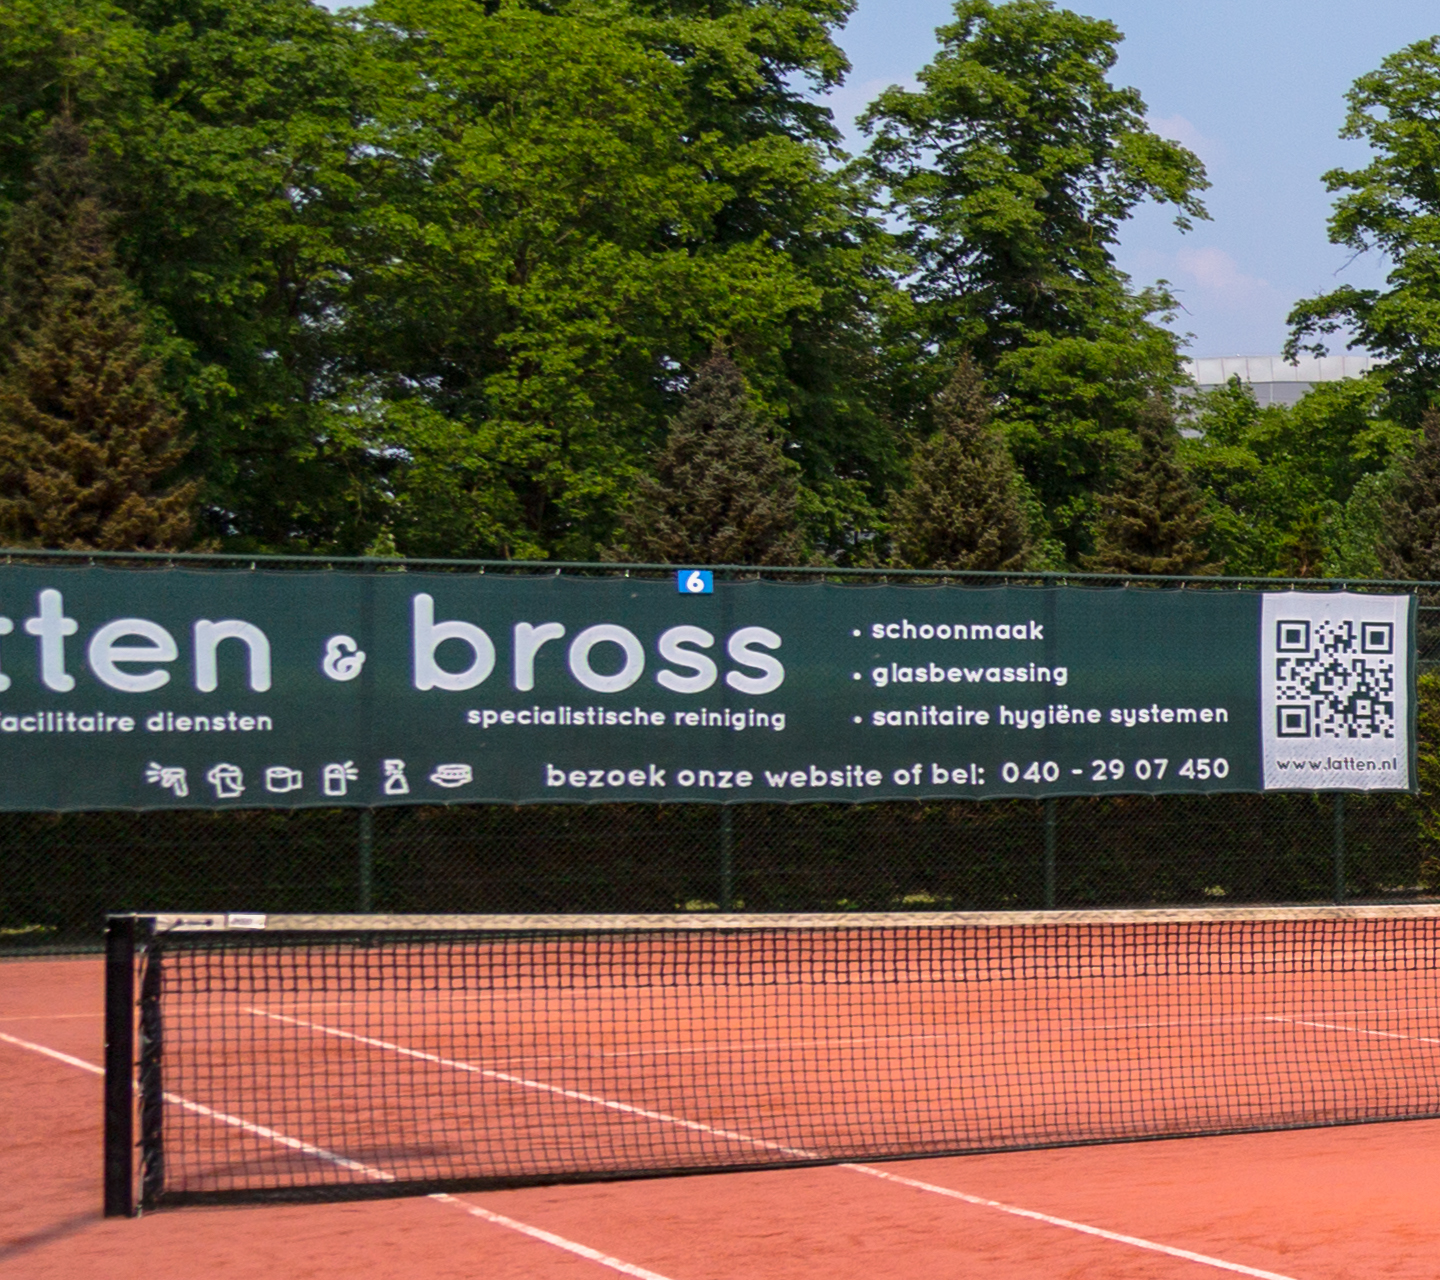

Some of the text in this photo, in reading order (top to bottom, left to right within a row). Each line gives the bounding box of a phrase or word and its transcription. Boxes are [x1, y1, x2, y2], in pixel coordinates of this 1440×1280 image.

[686, 571, 704, 594] 6
[871, 618, 1044, 641] schoonmaak
[322, 634, 366, 682] &
[413, 593, 785, 695] bross
[871, 662, 1068, 688] glasbewassing
[0, 711, 273, 732] acilitaire diensten
[467, 705, 786, 732] specialistische reiniging
[872, 703, 1229, 730] sanitaire hygiëne systemen
[546, 763, 666, 788] bezoek
[677, 769, 754, 789] onze
[764, 764, 883, 788] website
[893, 763, 923, 786] of
[931, 762, 985, 785] bel:
[1001, 760, 1060, 784] 040
[1091, 758, 1125, 781] 29
[1135, 758, 1169, 781] 07
[1178, 757, 1230, 780] 450
[1276, 756, 1397, 771] www.latten.nl
